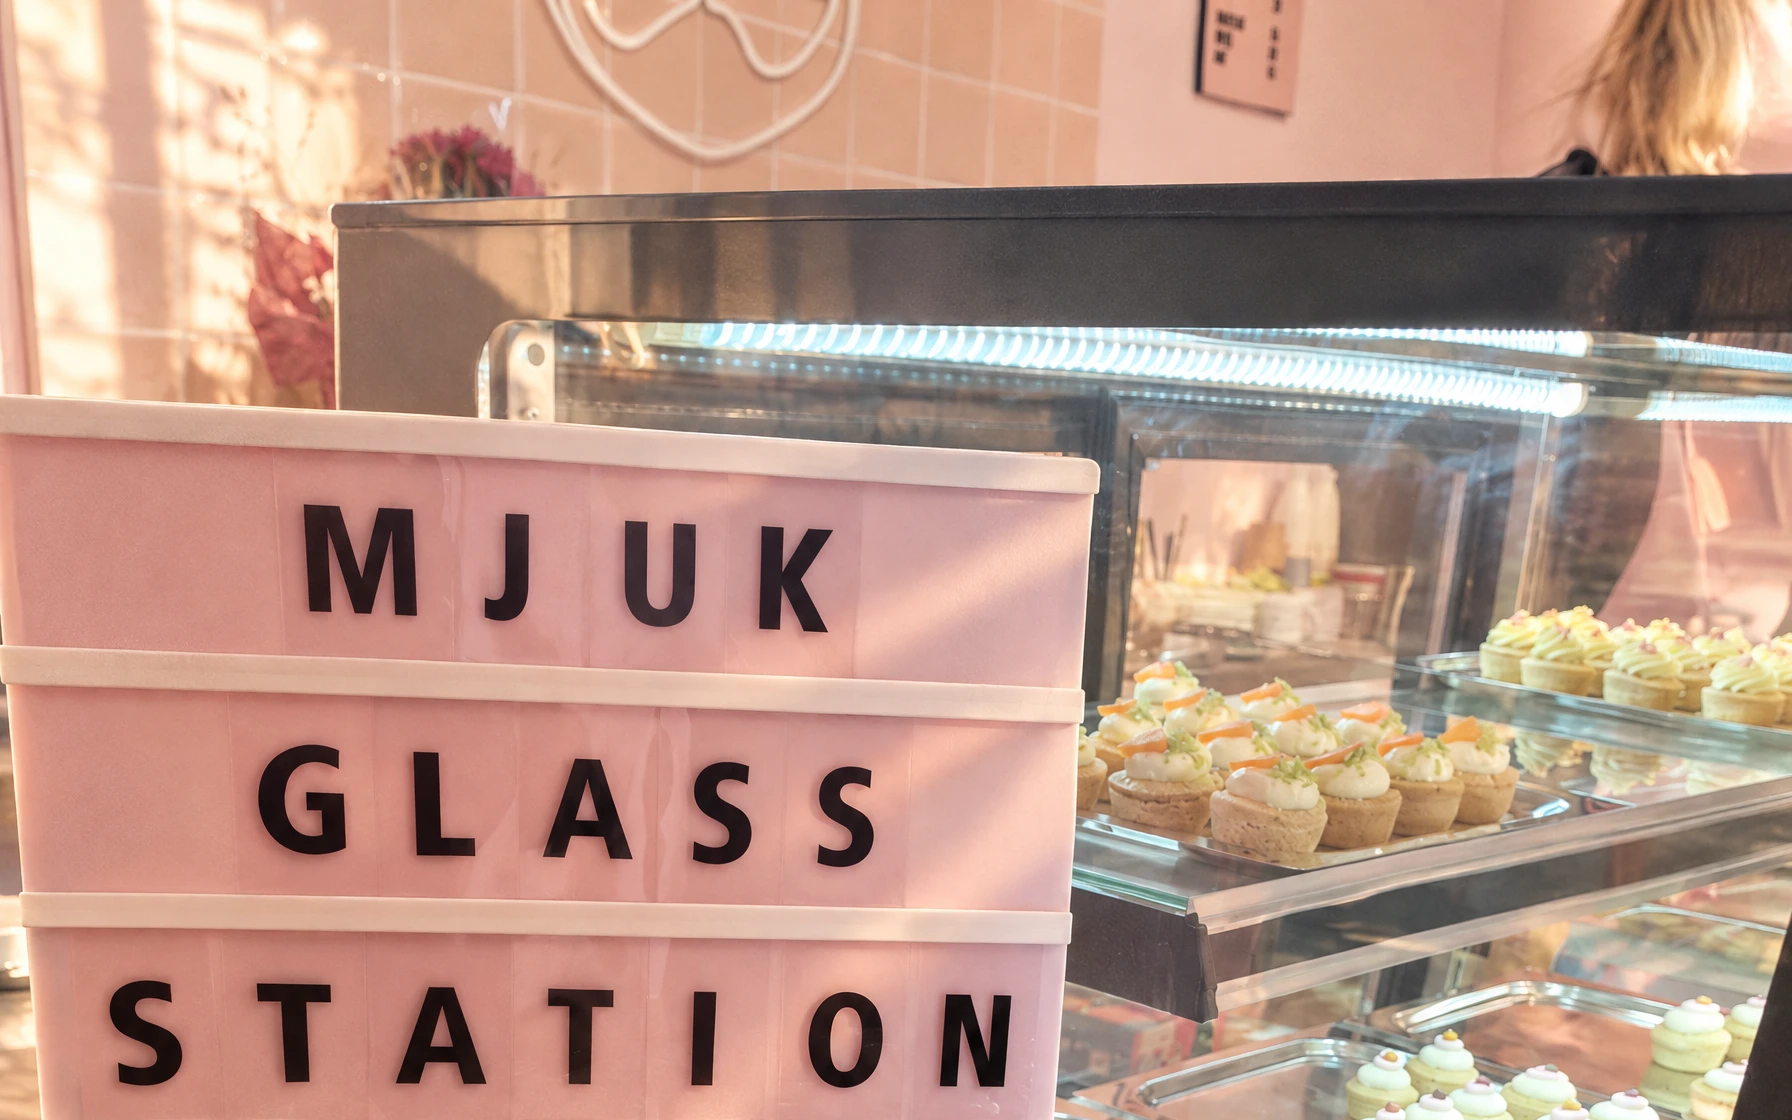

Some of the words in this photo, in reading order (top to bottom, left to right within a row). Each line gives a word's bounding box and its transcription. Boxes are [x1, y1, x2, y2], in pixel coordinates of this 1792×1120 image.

[302, 504, 834, 633] MJUK
[257, 744, 875, 868] GLASS
[108, 979, 1012, 1089] STATION
